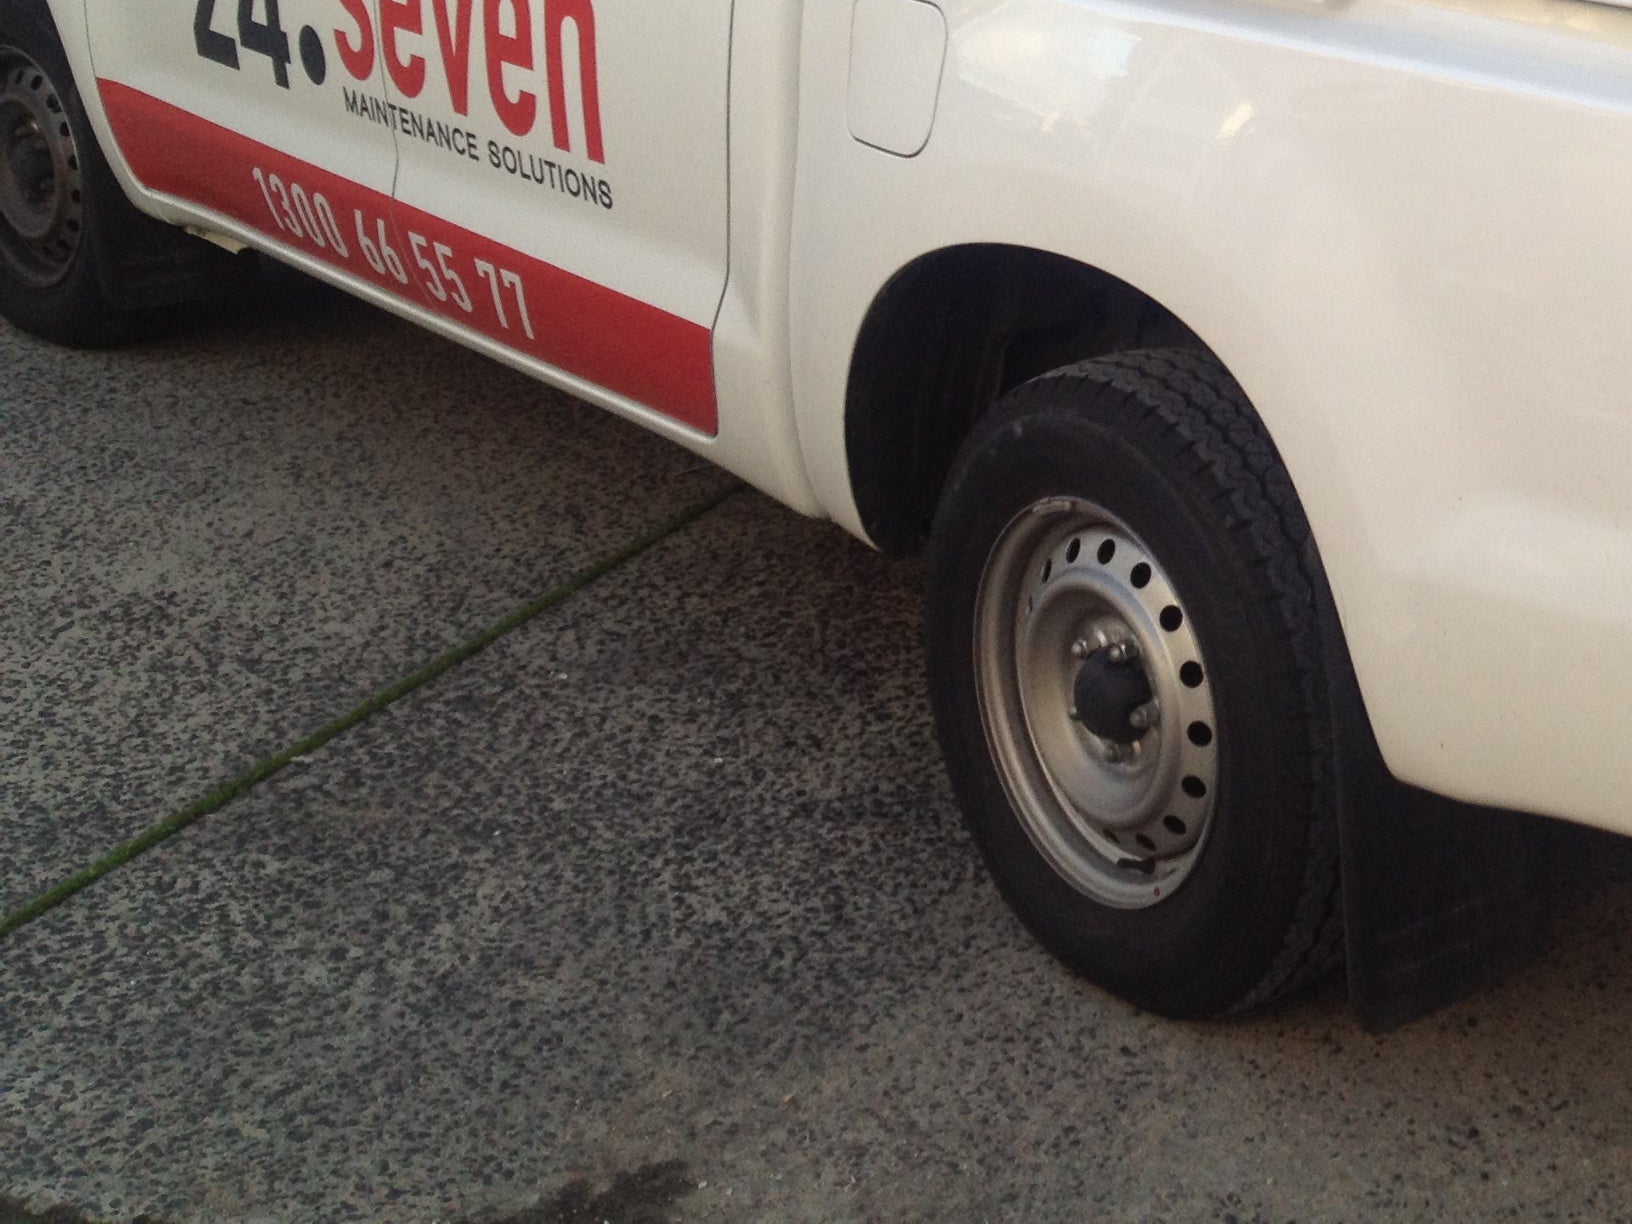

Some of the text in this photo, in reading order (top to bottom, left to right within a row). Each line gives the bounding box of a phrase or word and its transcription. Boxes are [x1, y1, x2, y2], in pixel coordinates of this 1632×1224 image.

[342, 86, 613, 210] MAINTENANCE SOLUTIONS
[252, 167, 535, 340] 1300 66 55 77
